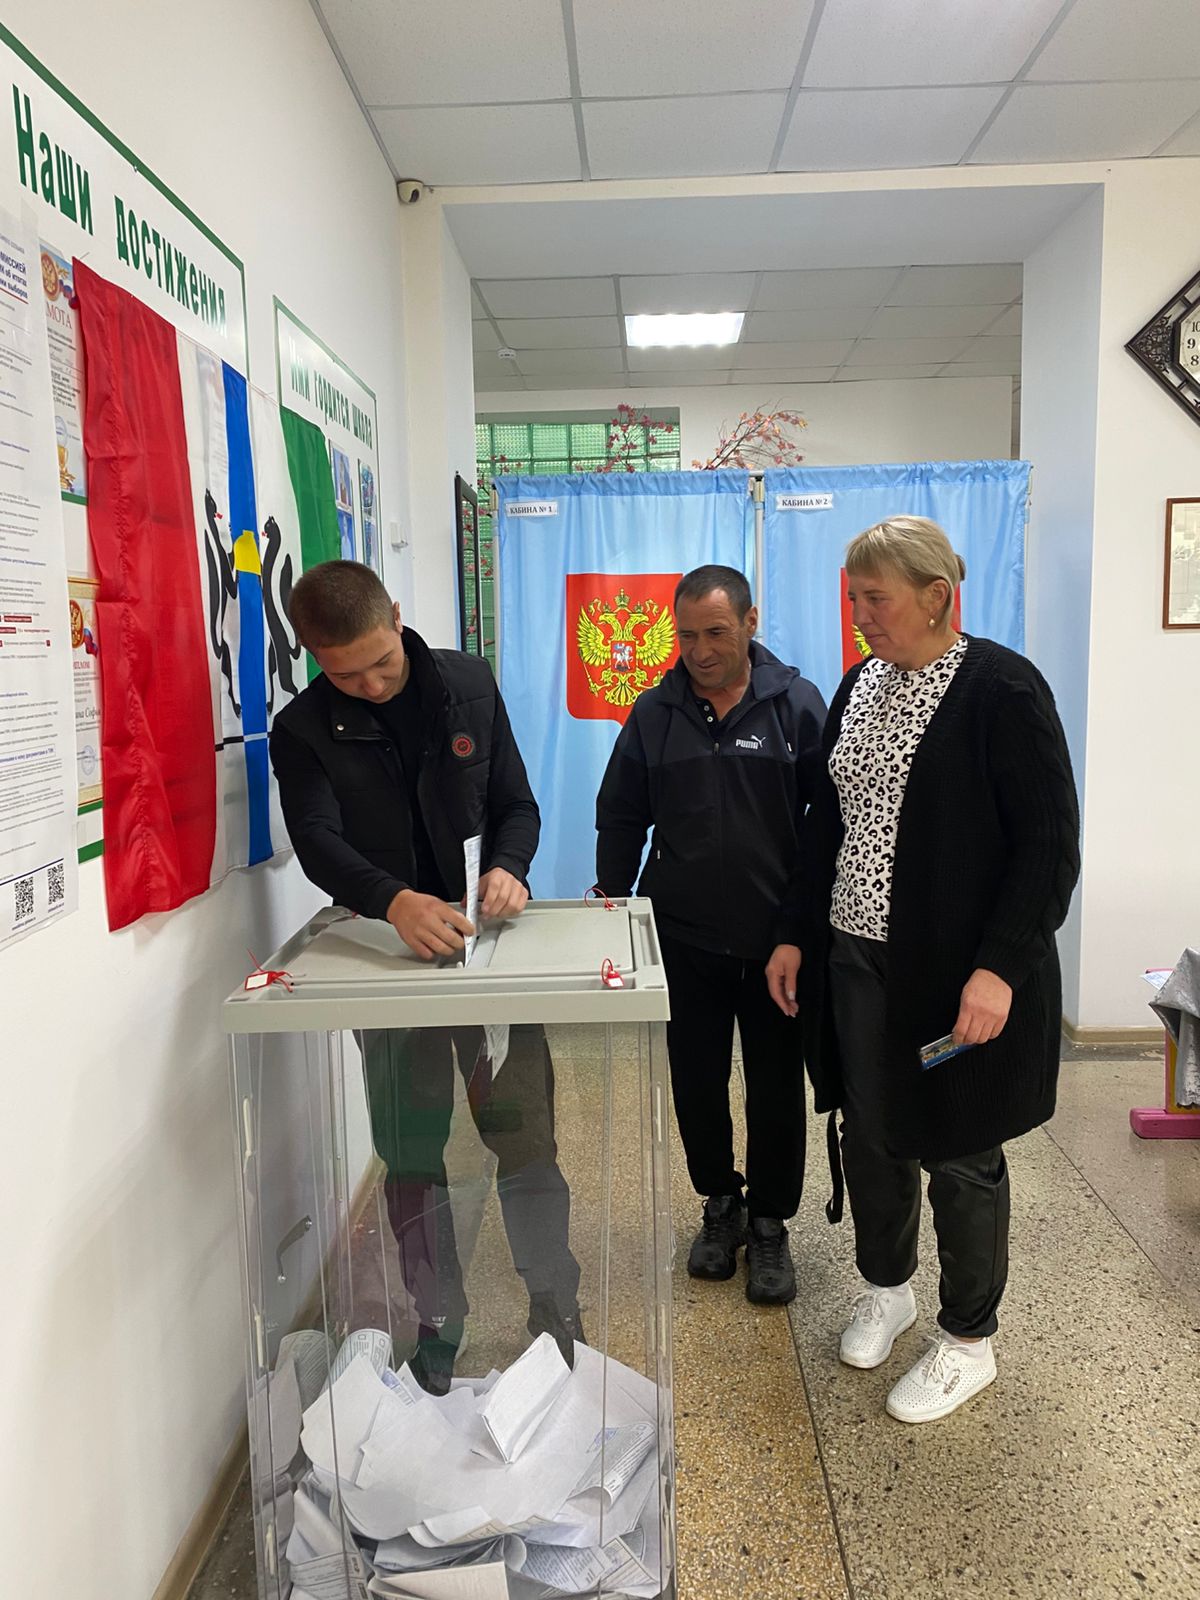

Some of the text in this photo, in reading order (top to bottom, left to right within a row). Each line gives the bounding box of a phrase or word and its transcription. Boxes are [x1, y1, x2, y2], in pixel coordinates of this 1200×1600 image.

[12, 83, 226, 336] Наши достижения
[1187, 338, 1196, 349] 9
[1190, 355, 1199, 366] 8
[781, 498, 814, 507] КАБИНА
[509, 505, 538, 514] КАБИНА
[735, 739, 759, 750] PUMA
